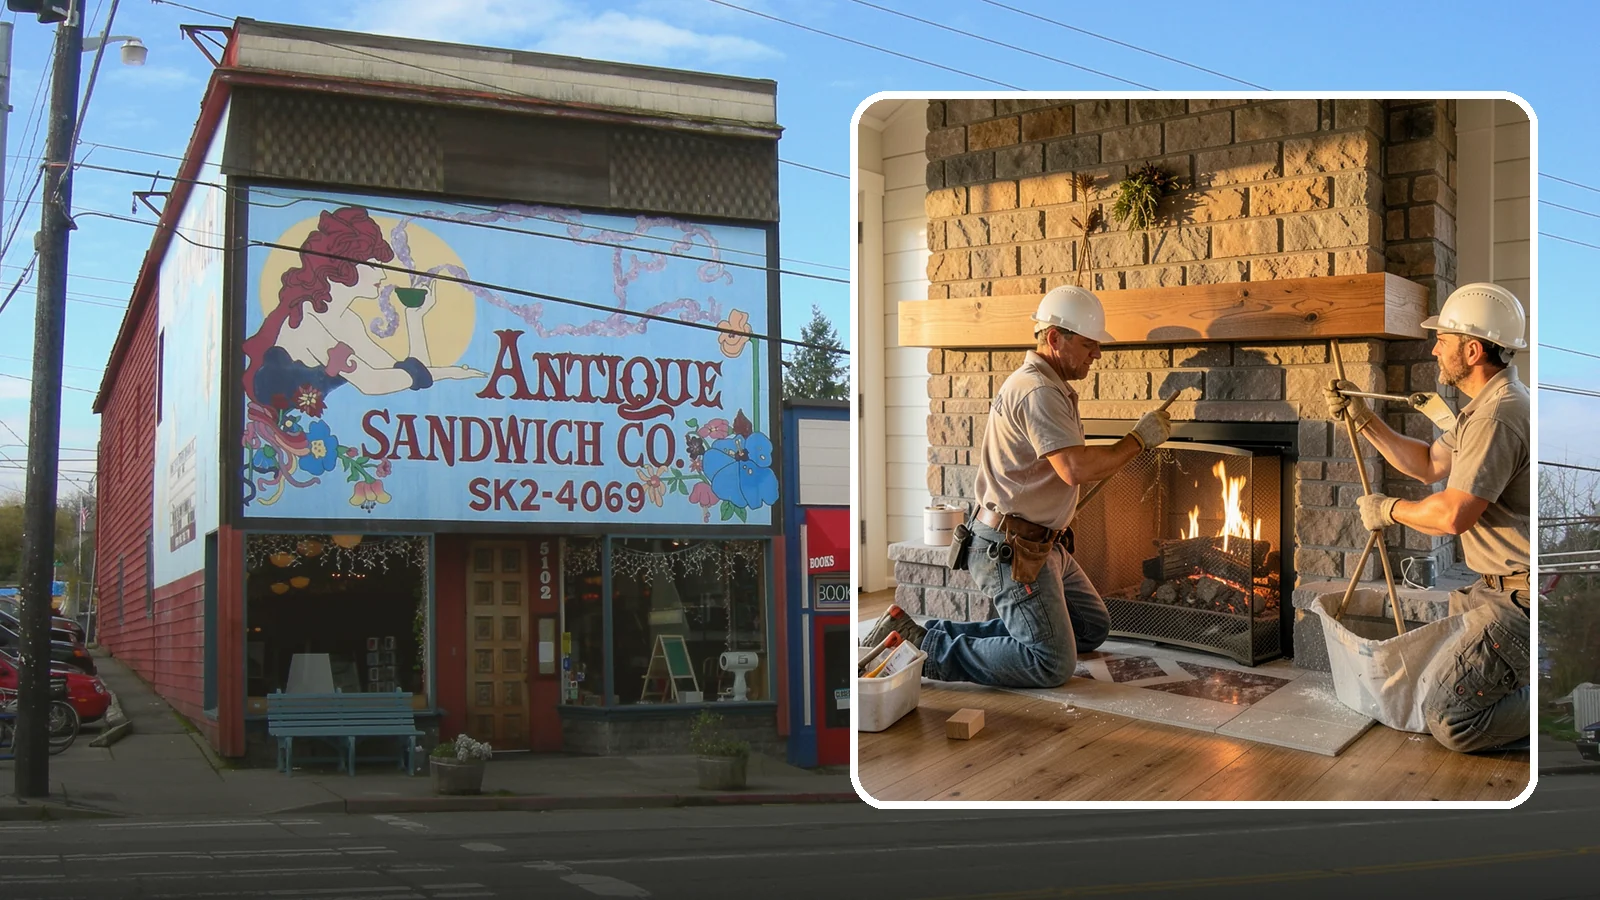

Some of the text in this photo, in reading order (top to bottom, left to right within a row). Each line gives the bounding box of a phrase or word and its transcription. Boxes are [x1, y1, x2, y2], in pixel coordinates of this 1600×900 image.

[476, 329, 724, 420] ANTIQUE
[361, 408, 685, 468] SANDWICH CO.
[468, 478, 645, 512] SK2-4069
[539, 541, 552, 600] 5102
[809, 554, 835, 569] BOOKS
